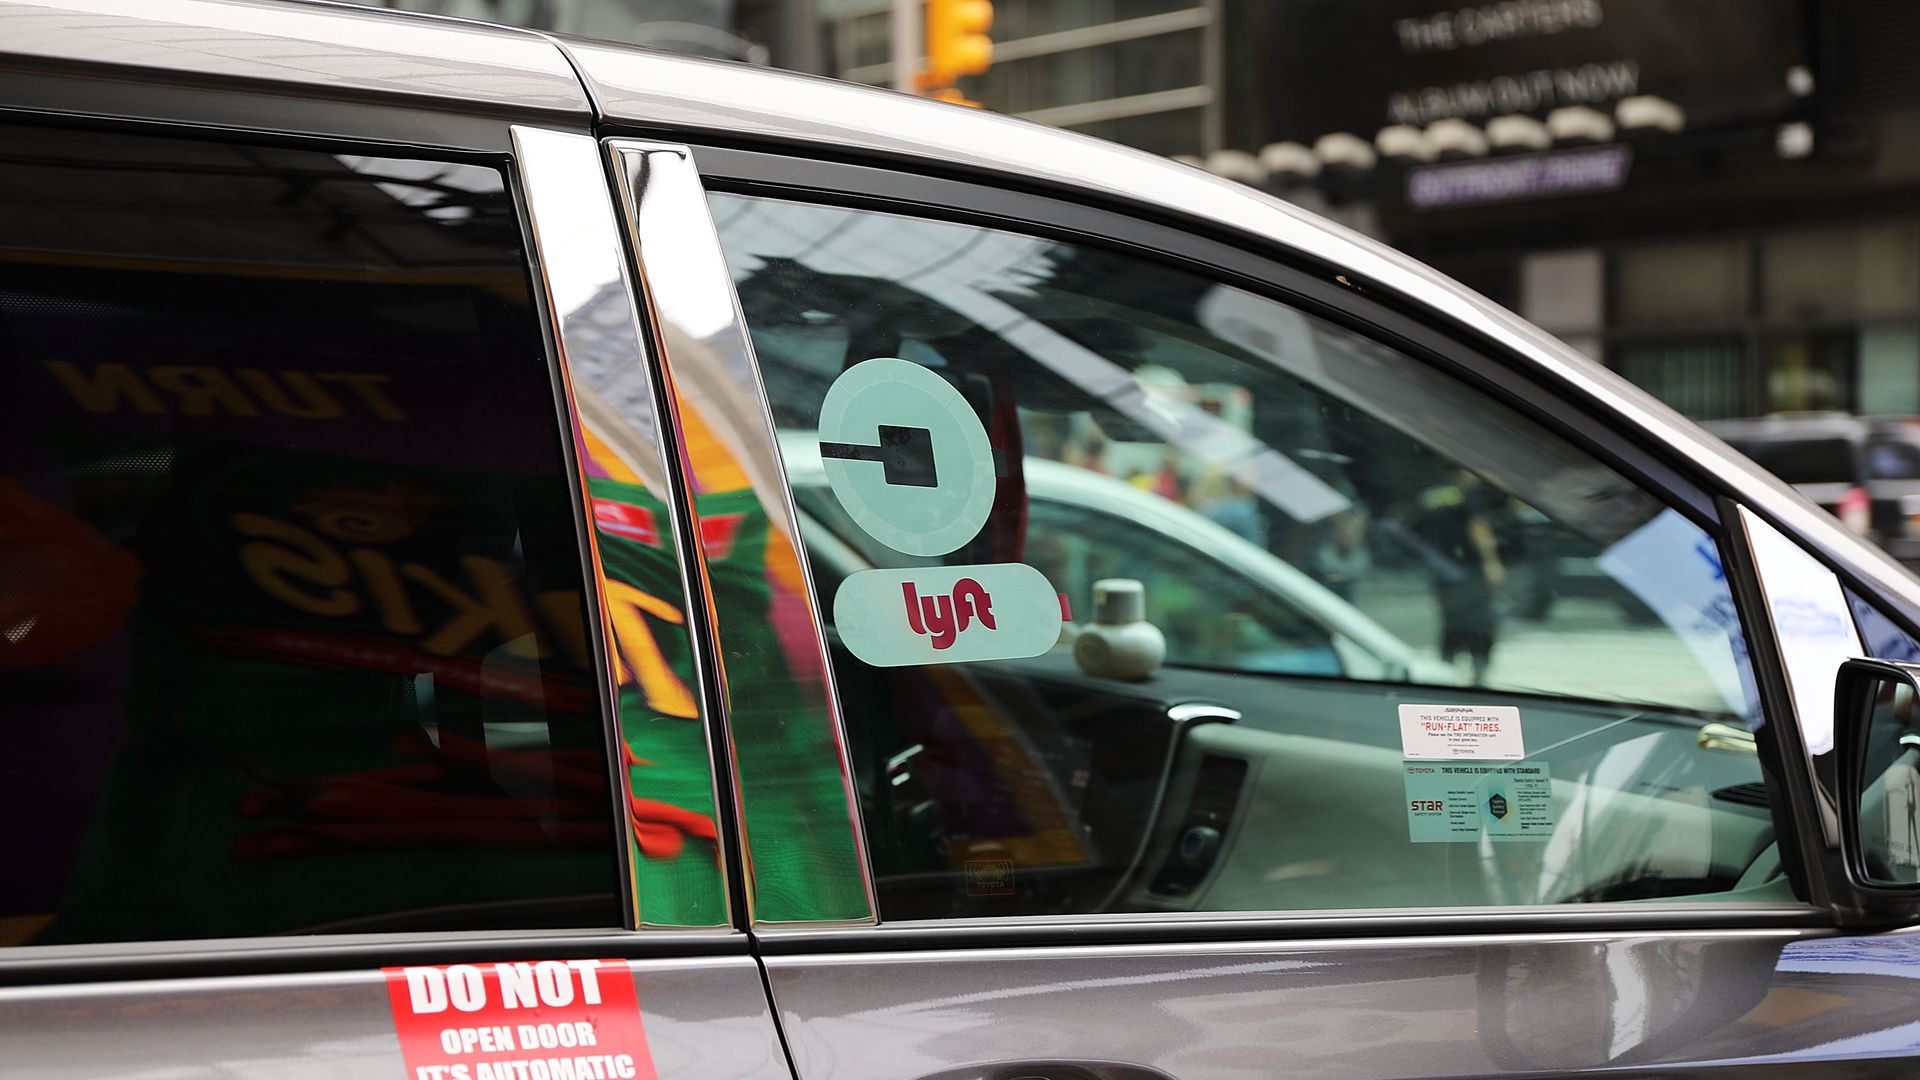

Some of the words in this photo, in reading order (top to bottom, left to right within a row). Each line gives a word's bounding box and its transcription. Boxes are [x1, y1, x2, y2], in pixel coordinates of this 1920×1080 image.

[1397, 12, 1455, 51] THE
[1488, 68, 1554, 112] OUT
[1554, 59, 1638, 102] NOW
[902, 578, 997, 650] lyft
[404, 966, 487, 1014] DO
[494, 960, 602, 1009] NOT
[440, 1026, 515, 1055] OPEN
[517, 1021, 597, 1050] DOOR
[476, 1054, 636, 1080] AUTOMATIC
